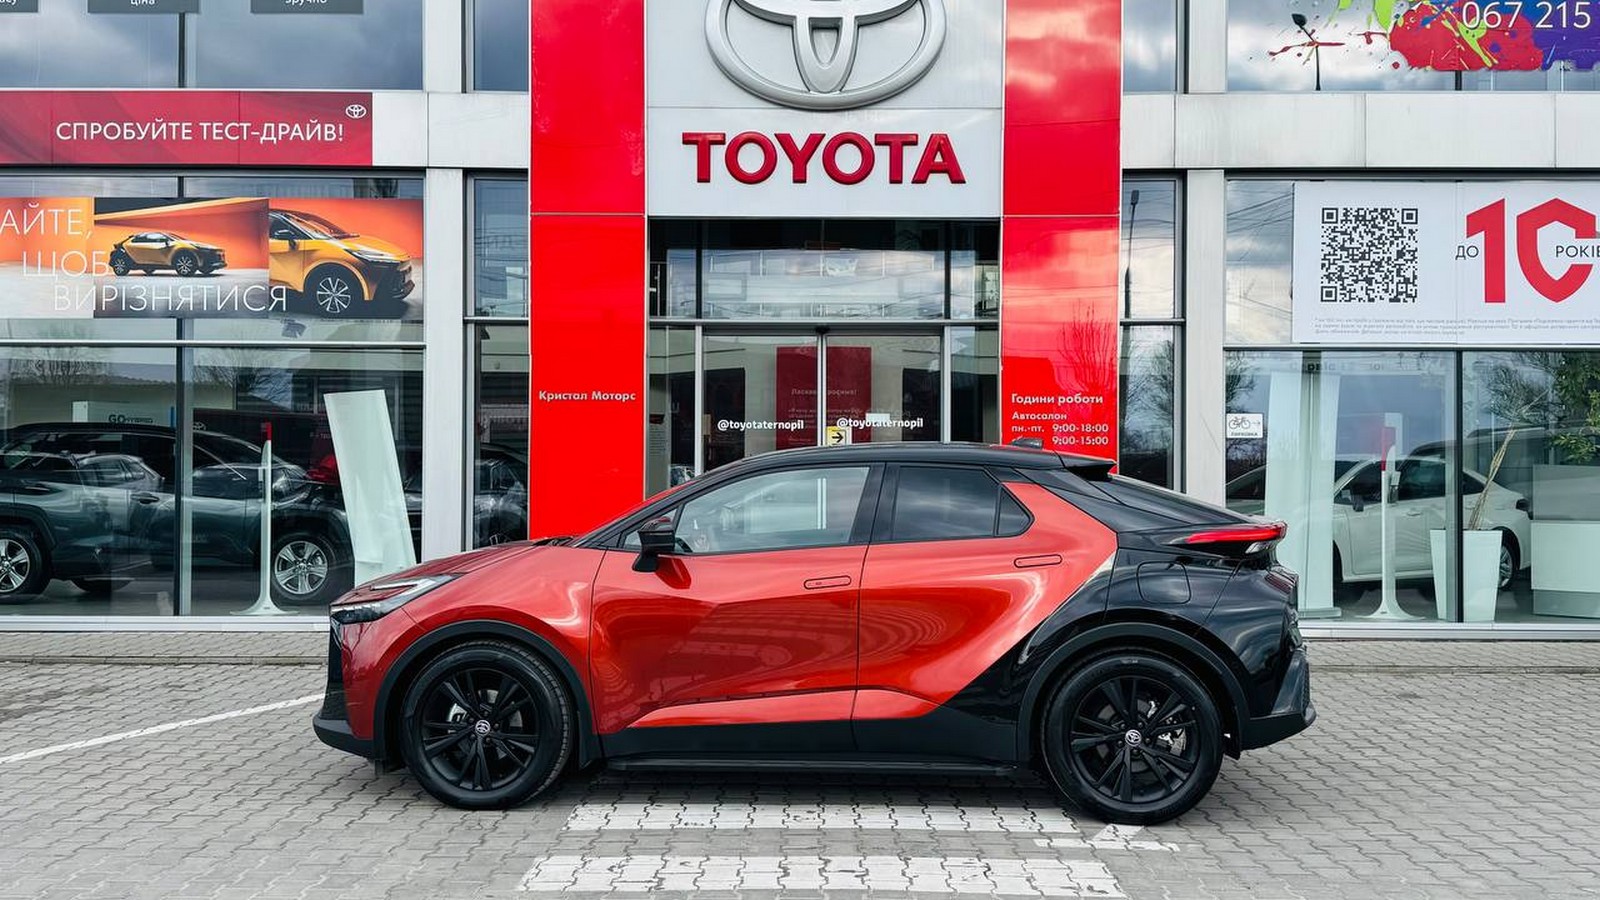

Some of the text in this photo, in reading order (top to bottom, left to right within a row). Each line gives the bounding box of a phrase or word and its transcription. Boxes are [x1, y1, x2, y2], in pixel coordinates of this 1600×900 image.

[1462, 1, 1591, 28] 067 215
[56, 118, 344, 144] СПРОБУЙТЕ ТЕСТ-ДРАЙВ!
[682, 131, 967, 185] TOYOTA
[0, 202, 94, 240] АЙТЕ,
[1455, 245, 1479, 261] ДО
[22, 250, 108, 281] ЩОБ
[54, 285, 287, 311] ВИРІЗНЯТИСЯ
[539, 390, 636, 402] Кристал Моторс
[1011, 392, 1103, 406] Години роботи
[1012, 411, 1067, 420] Автосалон
[717, 419, 804, 431] @toyotaternopil
[1052, 423, 1109, 433] 9:00-18:00
[1052, 436, 1109, 445] 9:00-15:00
